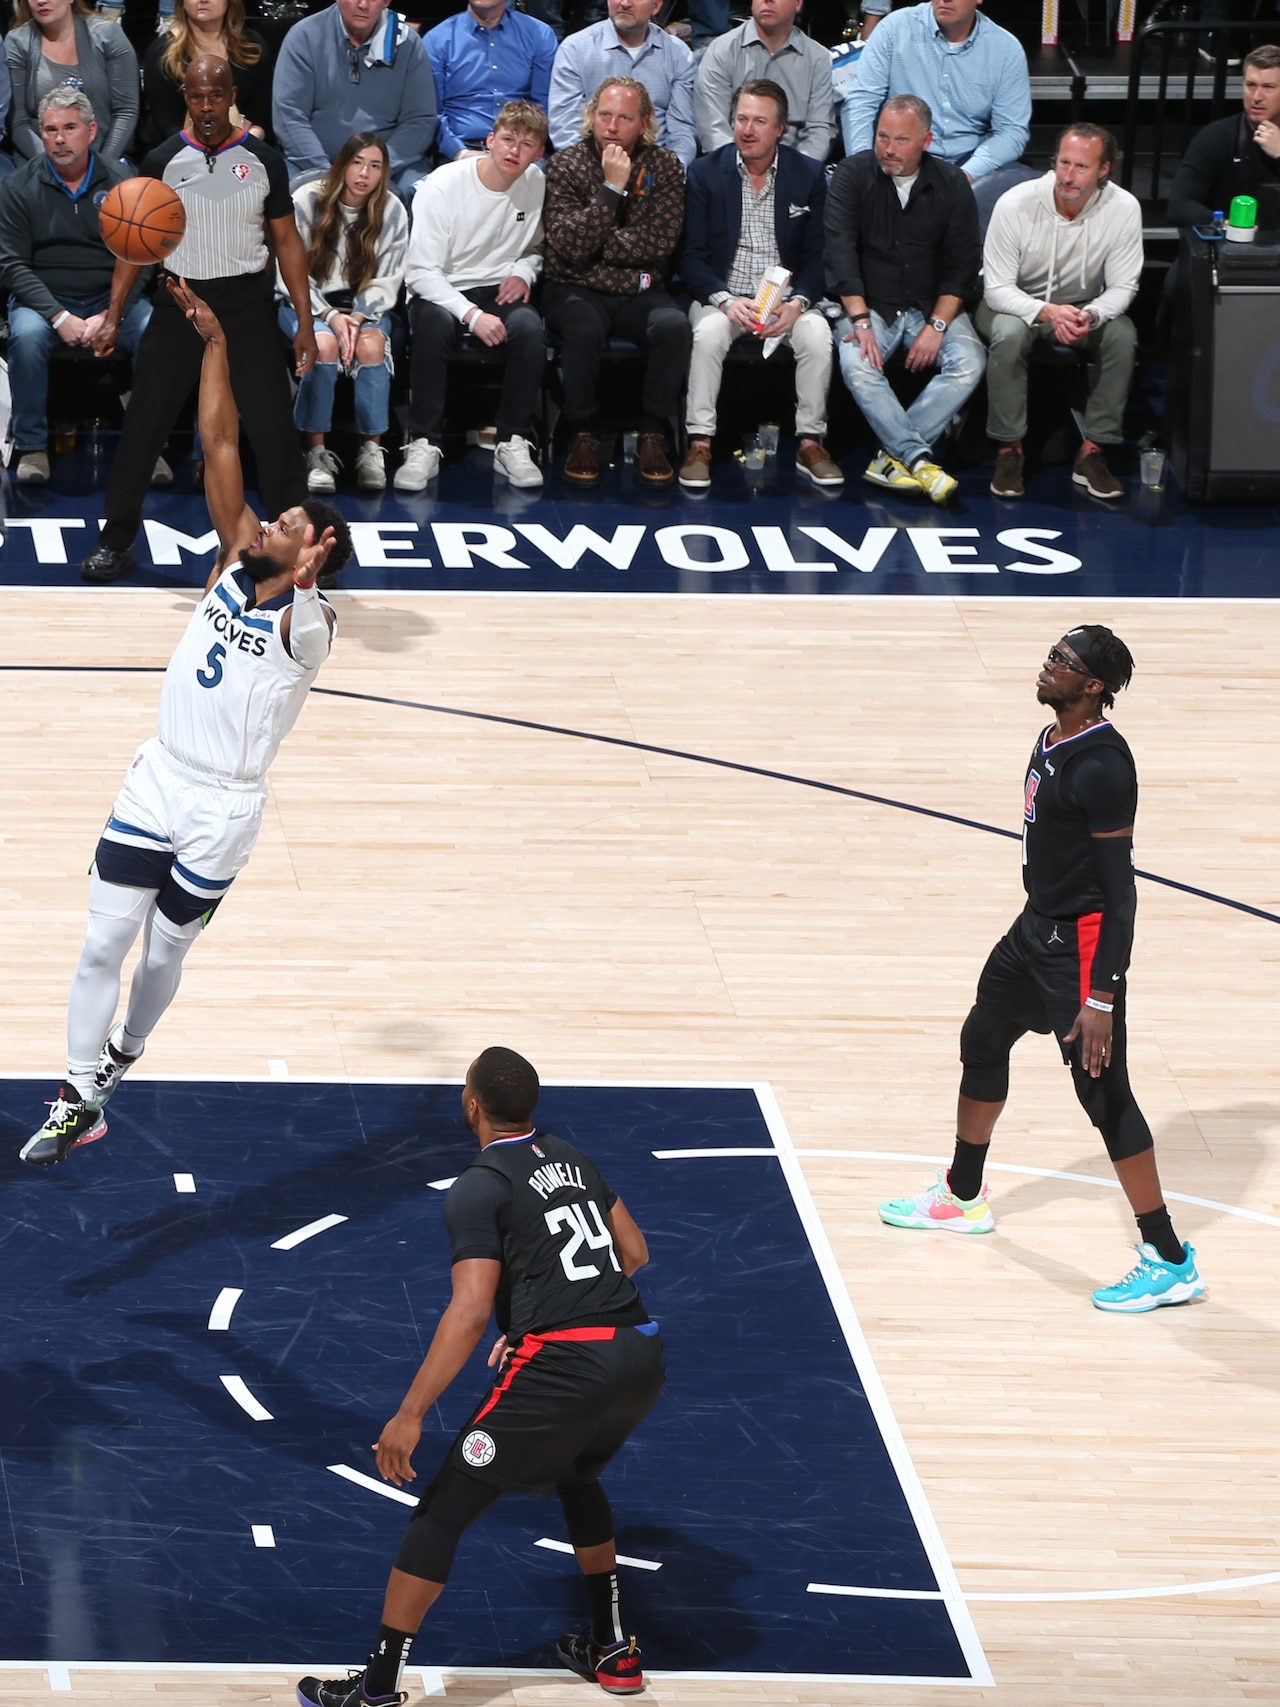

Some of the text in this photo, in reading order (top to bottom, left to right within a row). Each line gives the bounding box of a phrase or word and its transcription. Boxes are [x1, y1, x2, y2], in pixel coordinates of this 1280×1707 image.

[203, 599, 268, 657] WOLVES
[196, 641, 227, 689] 5
[528, 1162, 587, 1200] POWELL
[543, 1200, 622, 1282] 24
